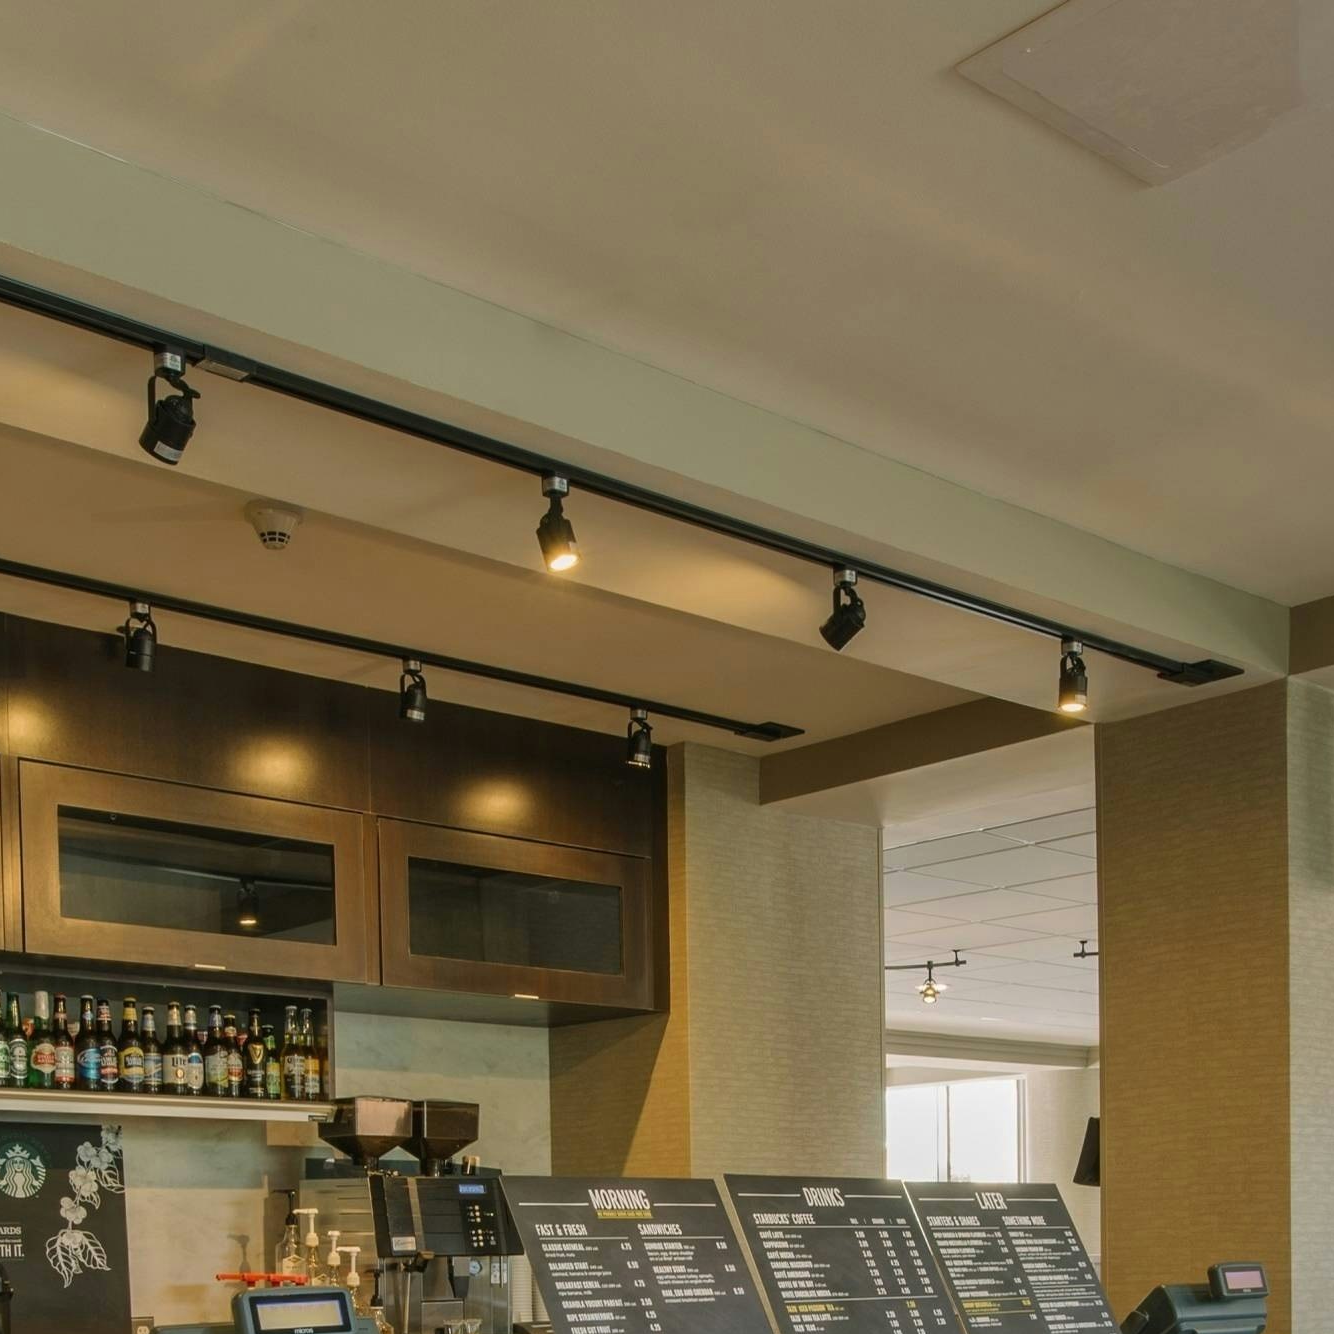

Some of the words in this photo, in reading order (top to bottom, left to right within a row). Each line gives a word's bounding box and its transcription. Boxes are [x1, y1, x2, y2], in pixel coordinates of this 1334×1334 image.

[588, 1189, 651, 1211] MORNING
[802, 1187, 846, 1207] DRINKS
[975, 1192, 1008, 1211] LATER
[791, 1213, 816, 1225] COFFEE
[535, 1224, 555, 1236] FAST
[555, 1224, 563, 1236] &
[563, 1224, 588, 1236] FRESH
[637, 1224, 683, 1236] SANDWICHES
